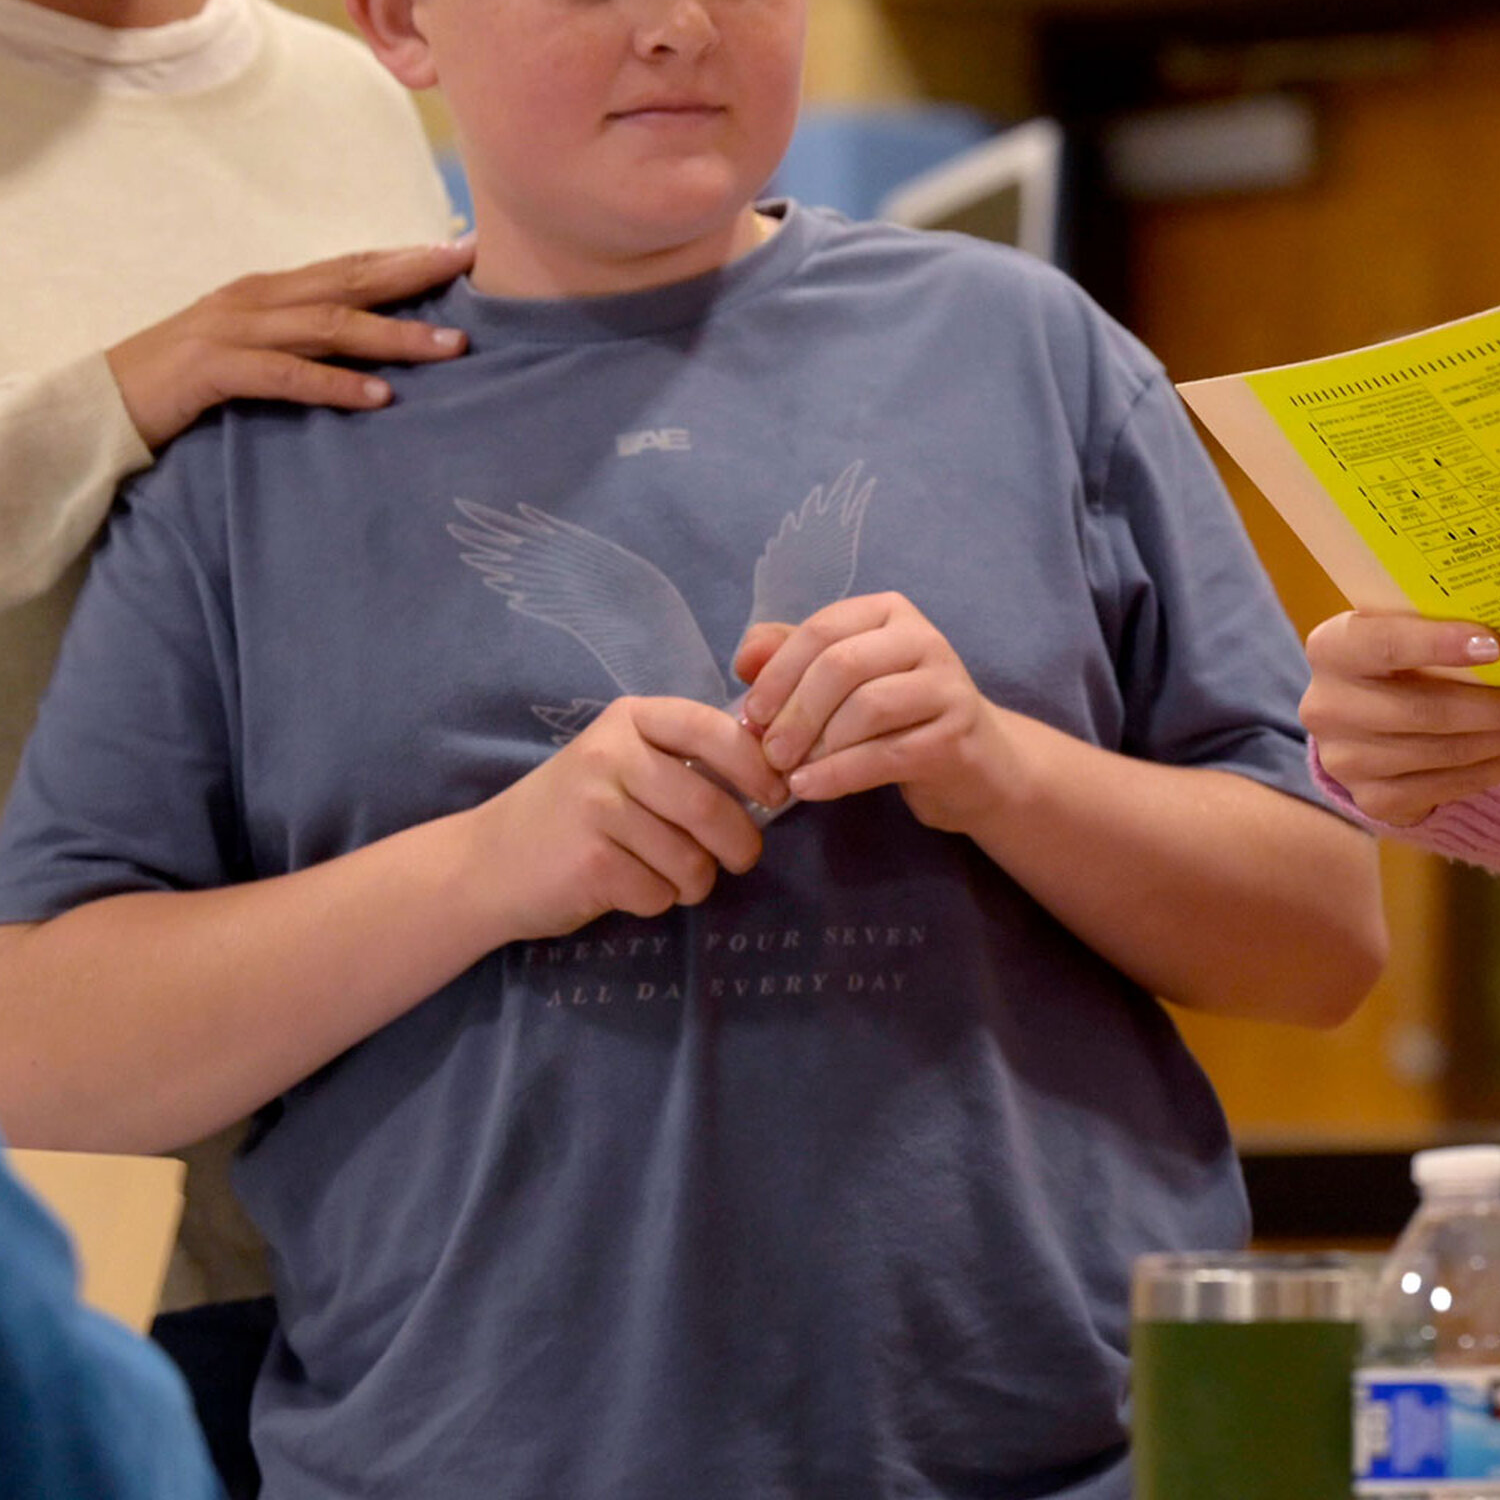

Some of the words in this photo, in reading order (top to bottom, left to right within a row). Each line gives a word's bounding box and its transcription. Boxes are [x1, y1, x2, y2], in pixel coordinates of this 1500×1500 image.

[525, 936, 667, 963] TWENTY
[706, 929, 800, 951] FOUR
[824, 925, 925, 946] SEVEN
[546, 985, 611, 1008] ALL
[710, 972, 829, 997] EVERY
[848, 972, 906, 992] DAY
